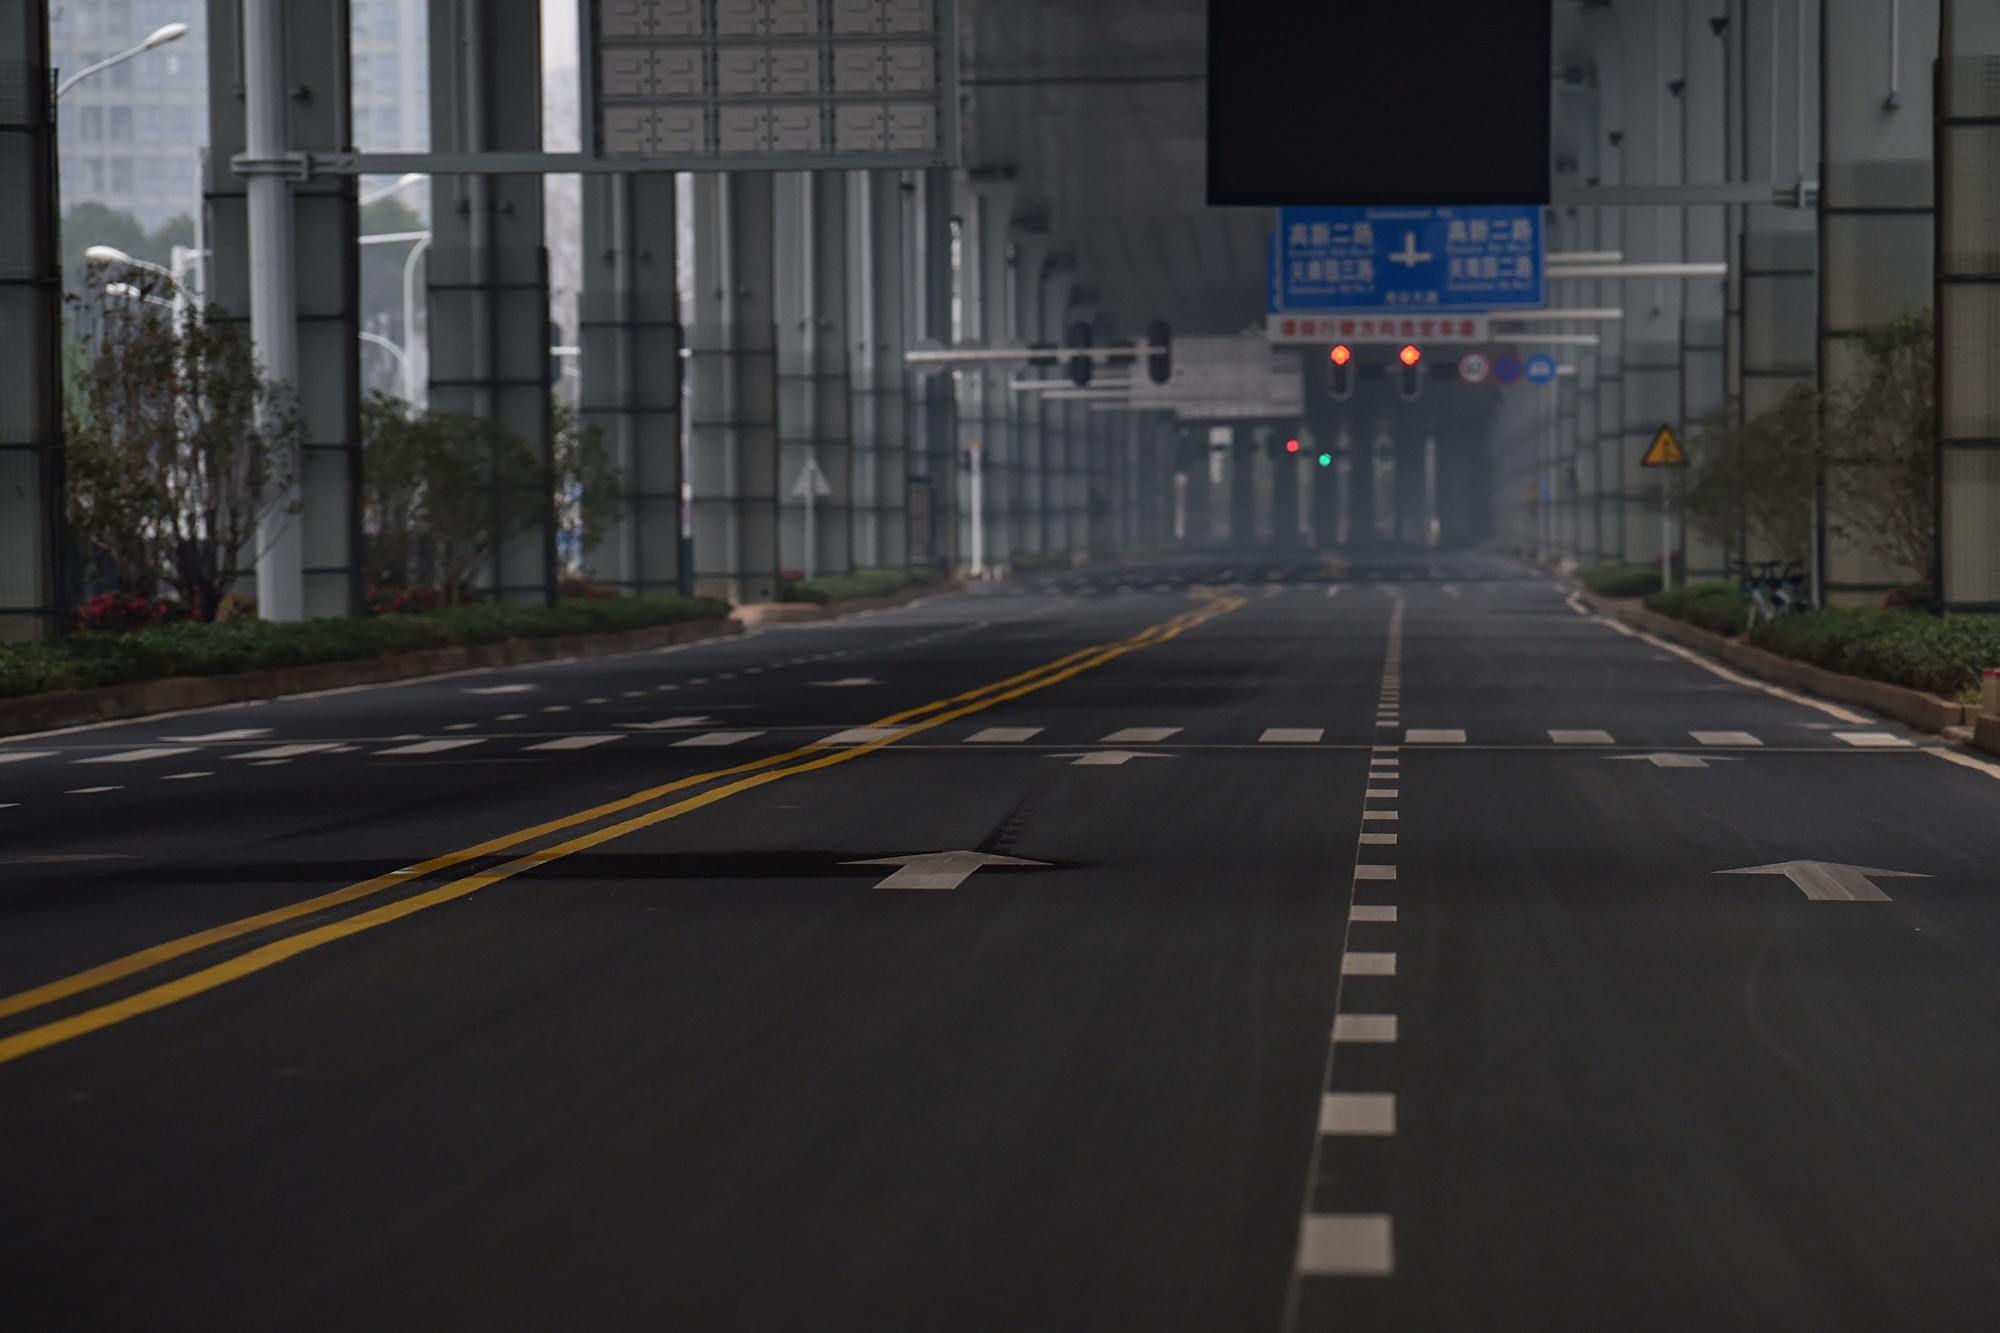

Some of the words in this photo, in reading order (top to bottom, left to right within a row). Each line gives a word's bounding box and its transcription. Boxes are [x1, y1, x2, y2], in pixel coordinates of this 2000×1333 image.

[1289, 222, 1374, 246] 高新二路
[1447, 218, 1532, 243] 高新二路
